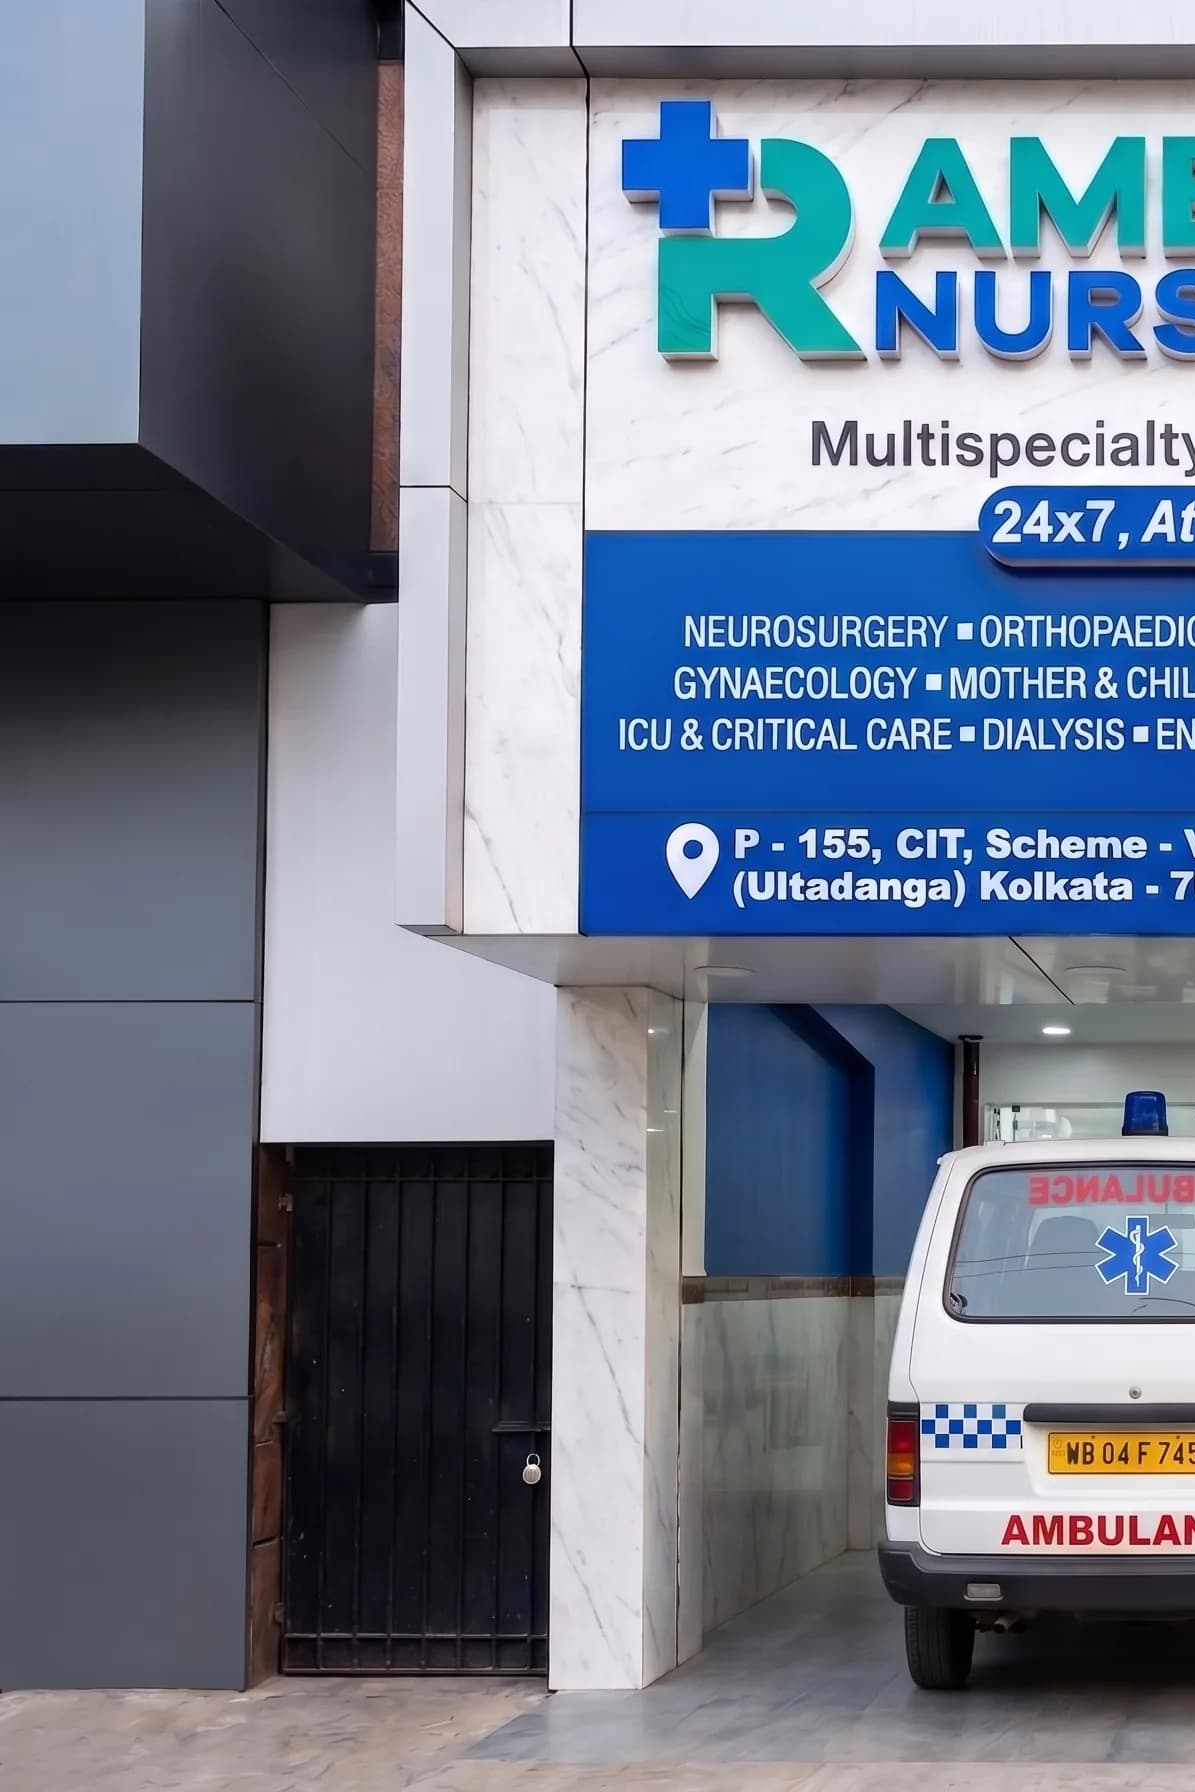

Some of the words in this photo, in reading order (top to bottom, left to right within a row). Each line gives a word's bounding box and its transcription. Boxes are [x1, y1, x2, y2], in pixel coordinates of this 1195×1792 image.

[992, 500, 1129, 550] 24x7,
[685, 615, 948, 647] NEUROSURGERY
[674, 667, 917, 699] GYNAECOLOGY
[950, 667, 1087, 699] MOTHER
[1094, 667, 1118, 699] &
[619, 719, 672, 750] ICU
[680, 719, 704, 750] &
[712, 719, 858, 750] CRITICAL
[866, 719, 952, 750] CARE
[983, 719, 1125, 750] DIALYSIS
[735, 829, 760, 859] P
[798, 828, 882, 865] 155,
[896, 828, 973, 865] CIT,
[986, 828, 1148, 859] Scheme
[733, 869, 966, 908] (Ultadanga)
[980, 870, 1133, 901] Kolkata
[1066, 1441, 1095, 1465] WB
[1102, 1441, 1129, 1465] 04
[1137, 1441, 1151, 1465] F
